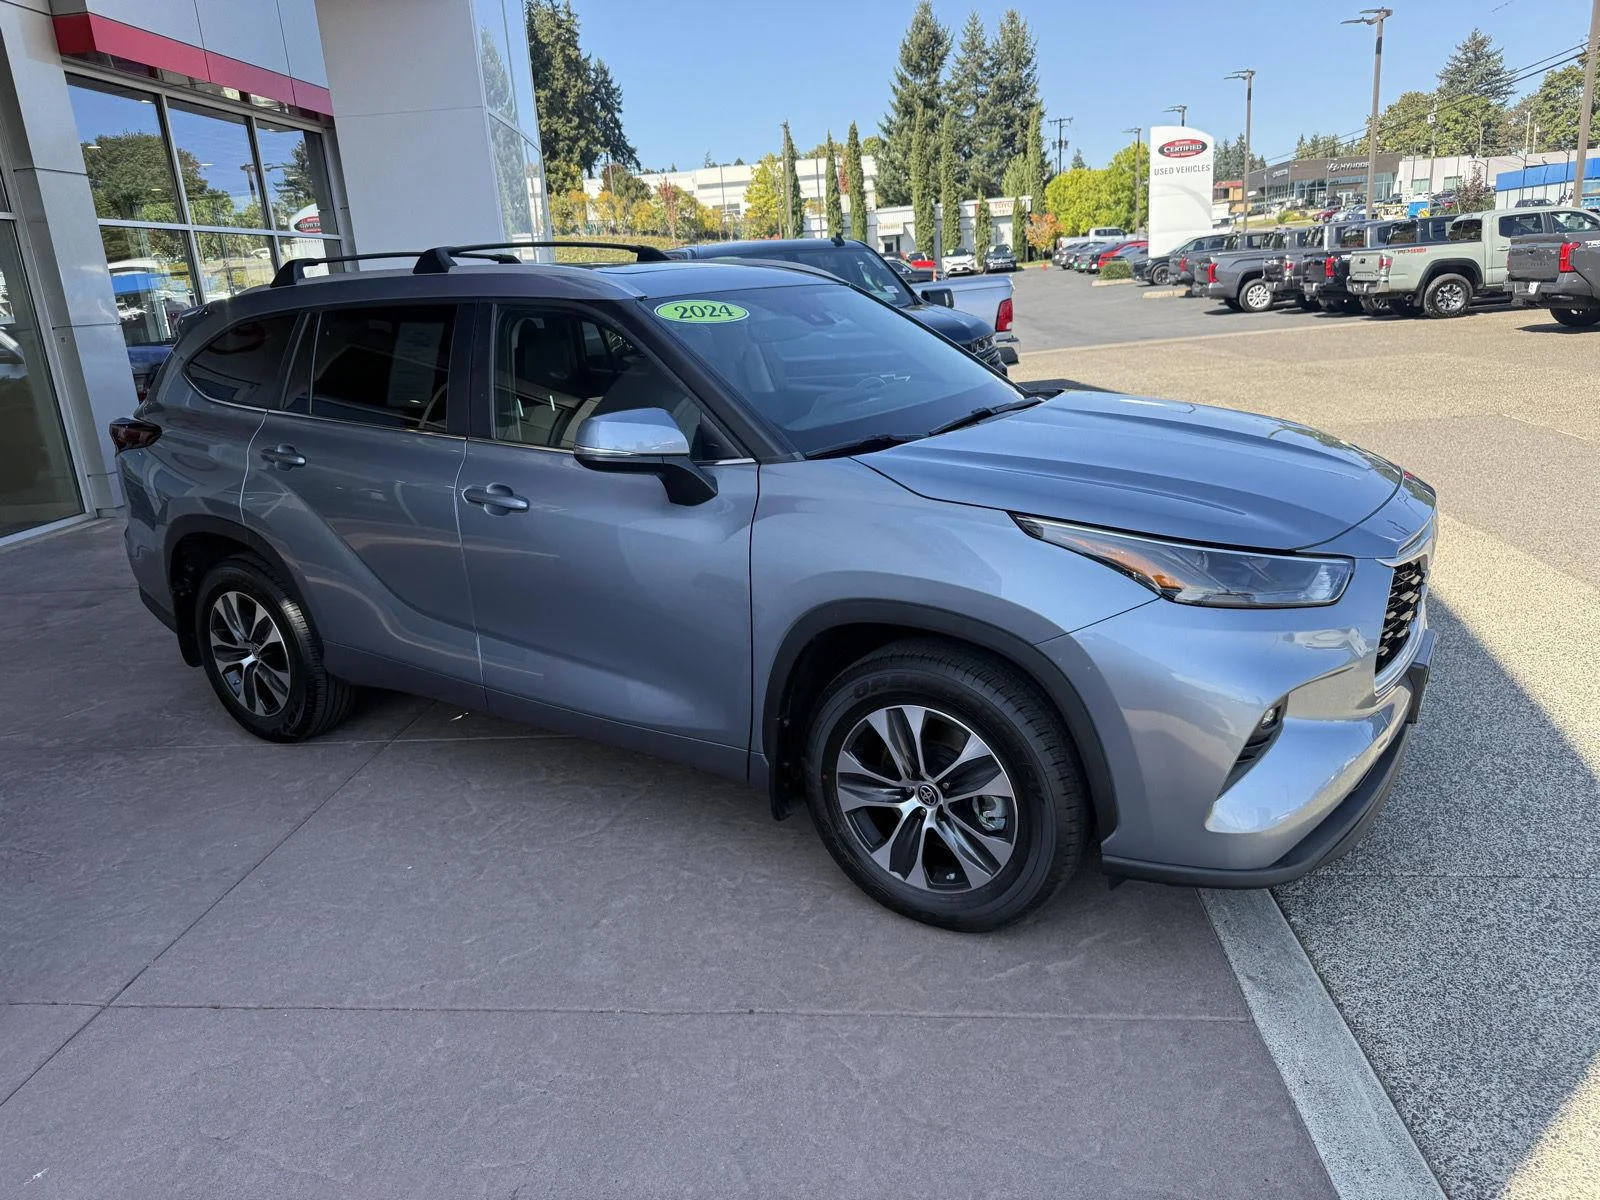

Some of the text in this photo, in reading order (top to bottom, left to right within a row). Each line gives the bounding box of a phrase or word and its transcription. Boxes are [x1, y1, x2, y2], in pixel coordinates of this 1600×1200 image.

[1164, 144, 1202, 153] CERTIFIED
[1154, 164, 1211, 176] USED VEHICLES
[1340, 161, 1370, 169] HYUNDA
[674, 304, 735, 319] 2024
